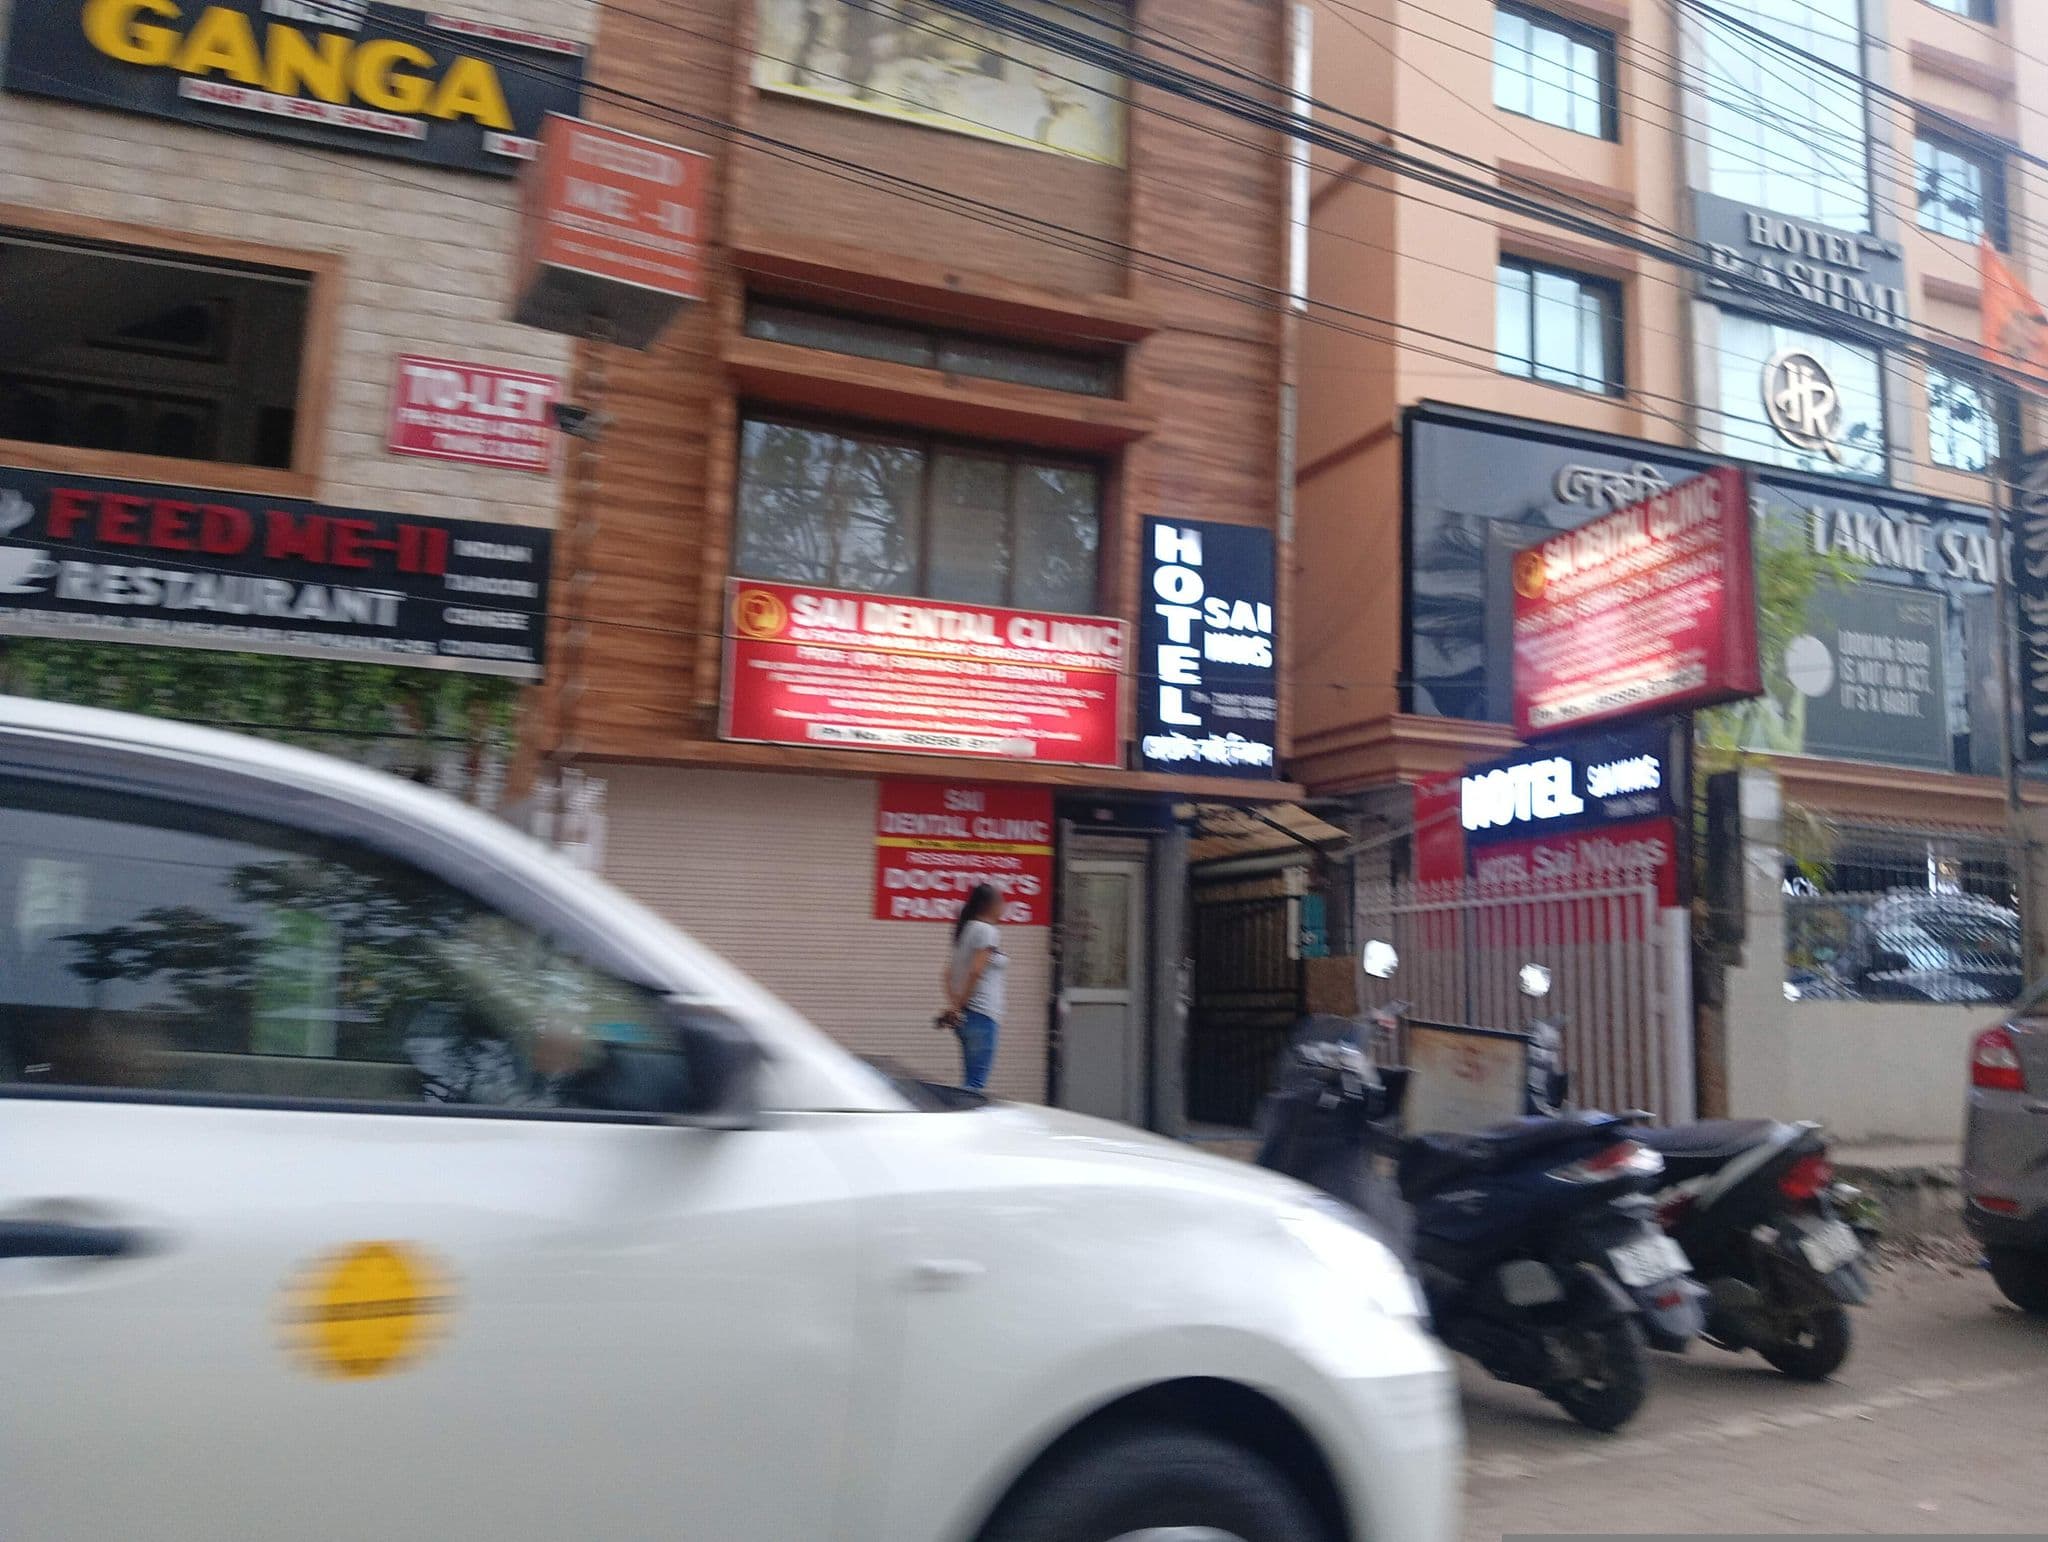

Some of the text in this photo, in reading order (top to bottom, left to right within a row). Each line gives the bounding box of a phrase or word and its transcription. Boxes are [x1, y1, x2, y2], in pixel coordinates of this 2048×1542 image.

[83, 0, 514, 130] GANGA
[1746, 211, 1870, 273] HOTEL
[401, 365, 554, 422] TO-LET
[47, 488, 449, 575] FEED ME-II
[56, 560, 407, 627] RESTAURANT
[1154, 524, 1204, 725] HOTEL
[1204, 597, 1272, 634] SAI
[789, 594, 1124, 660] SAI DENTAL CLINIC
[879, 811, 972, 838] DENTAL
[1462, 757, 1583, 830] HOTEL
